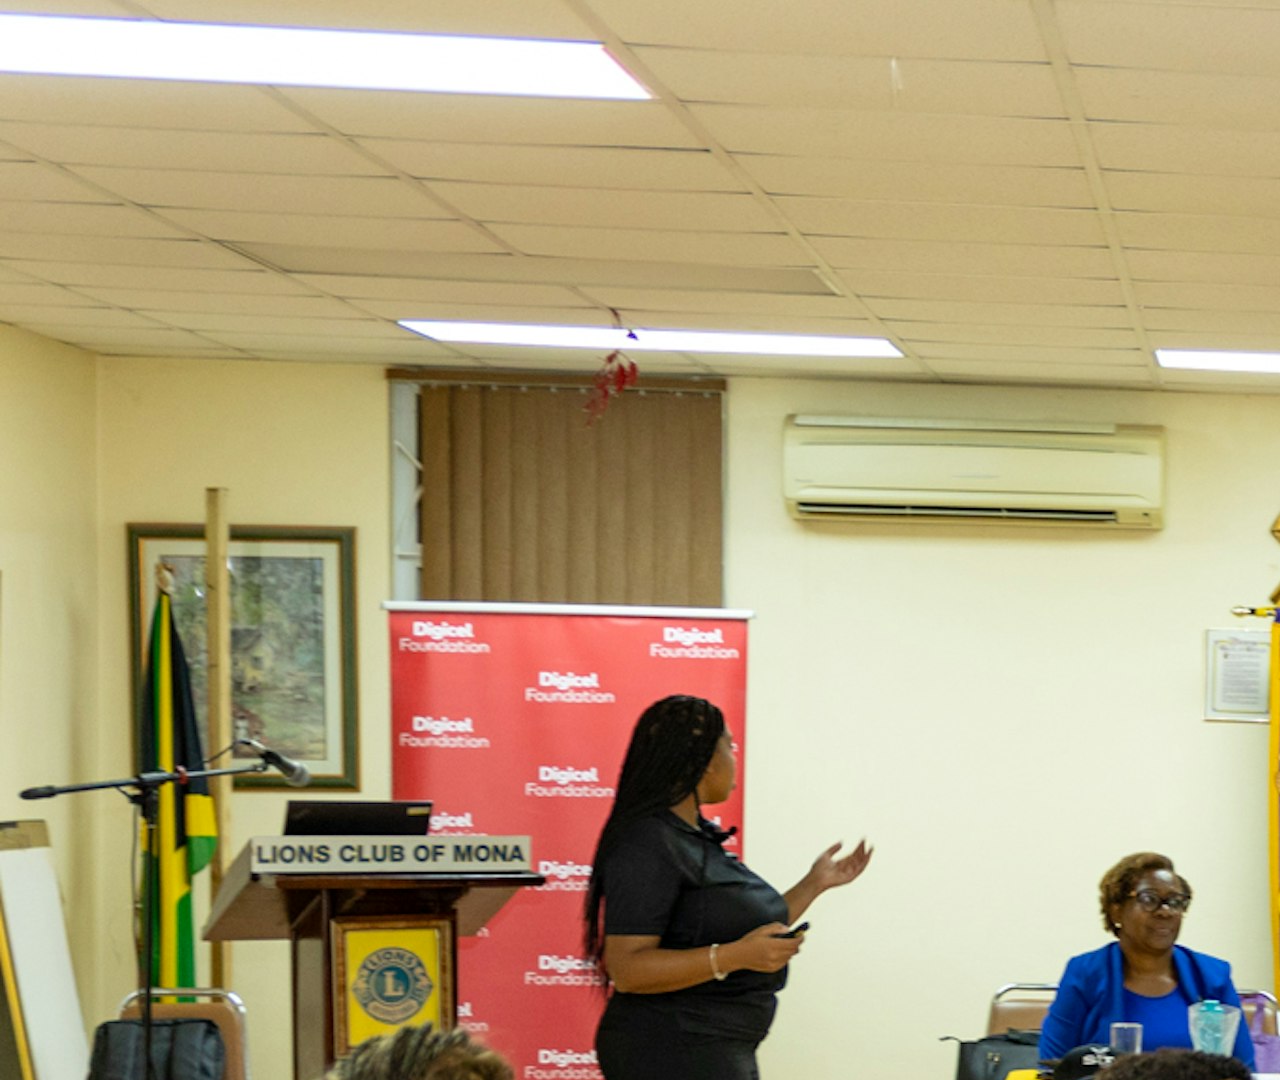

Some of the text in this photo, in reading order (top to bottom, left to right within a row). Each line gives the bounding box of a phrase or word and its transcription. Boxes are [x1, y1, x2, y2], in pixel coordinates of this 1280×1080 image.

[412, 621, 474, 639] Digicel
[663, 627, 724, 646] Digicel
[400, 639, 490, 653] Foundation
[650, 644, 739, 659] Foundation
[539, 672, 600, 690] Digicel
[525, 688, 615, 703] Foundation
[412, 716, 474, 733] Digicel
[400, 733, 490, 748] Foundation
[539, 766, 599, 784] Digicel
[525, 783, 616, 797] Foundation
[430, 813, 474, 829] gicel
[257, 844, 526, 864] LIONS CLUB OF MONA
[538, 861, 593, 879] Digice
[383, 970, 404, 997] L
[538, 1049, 599, 1067] Digicel
[524, 1066, 605, 1080] Foundatio
